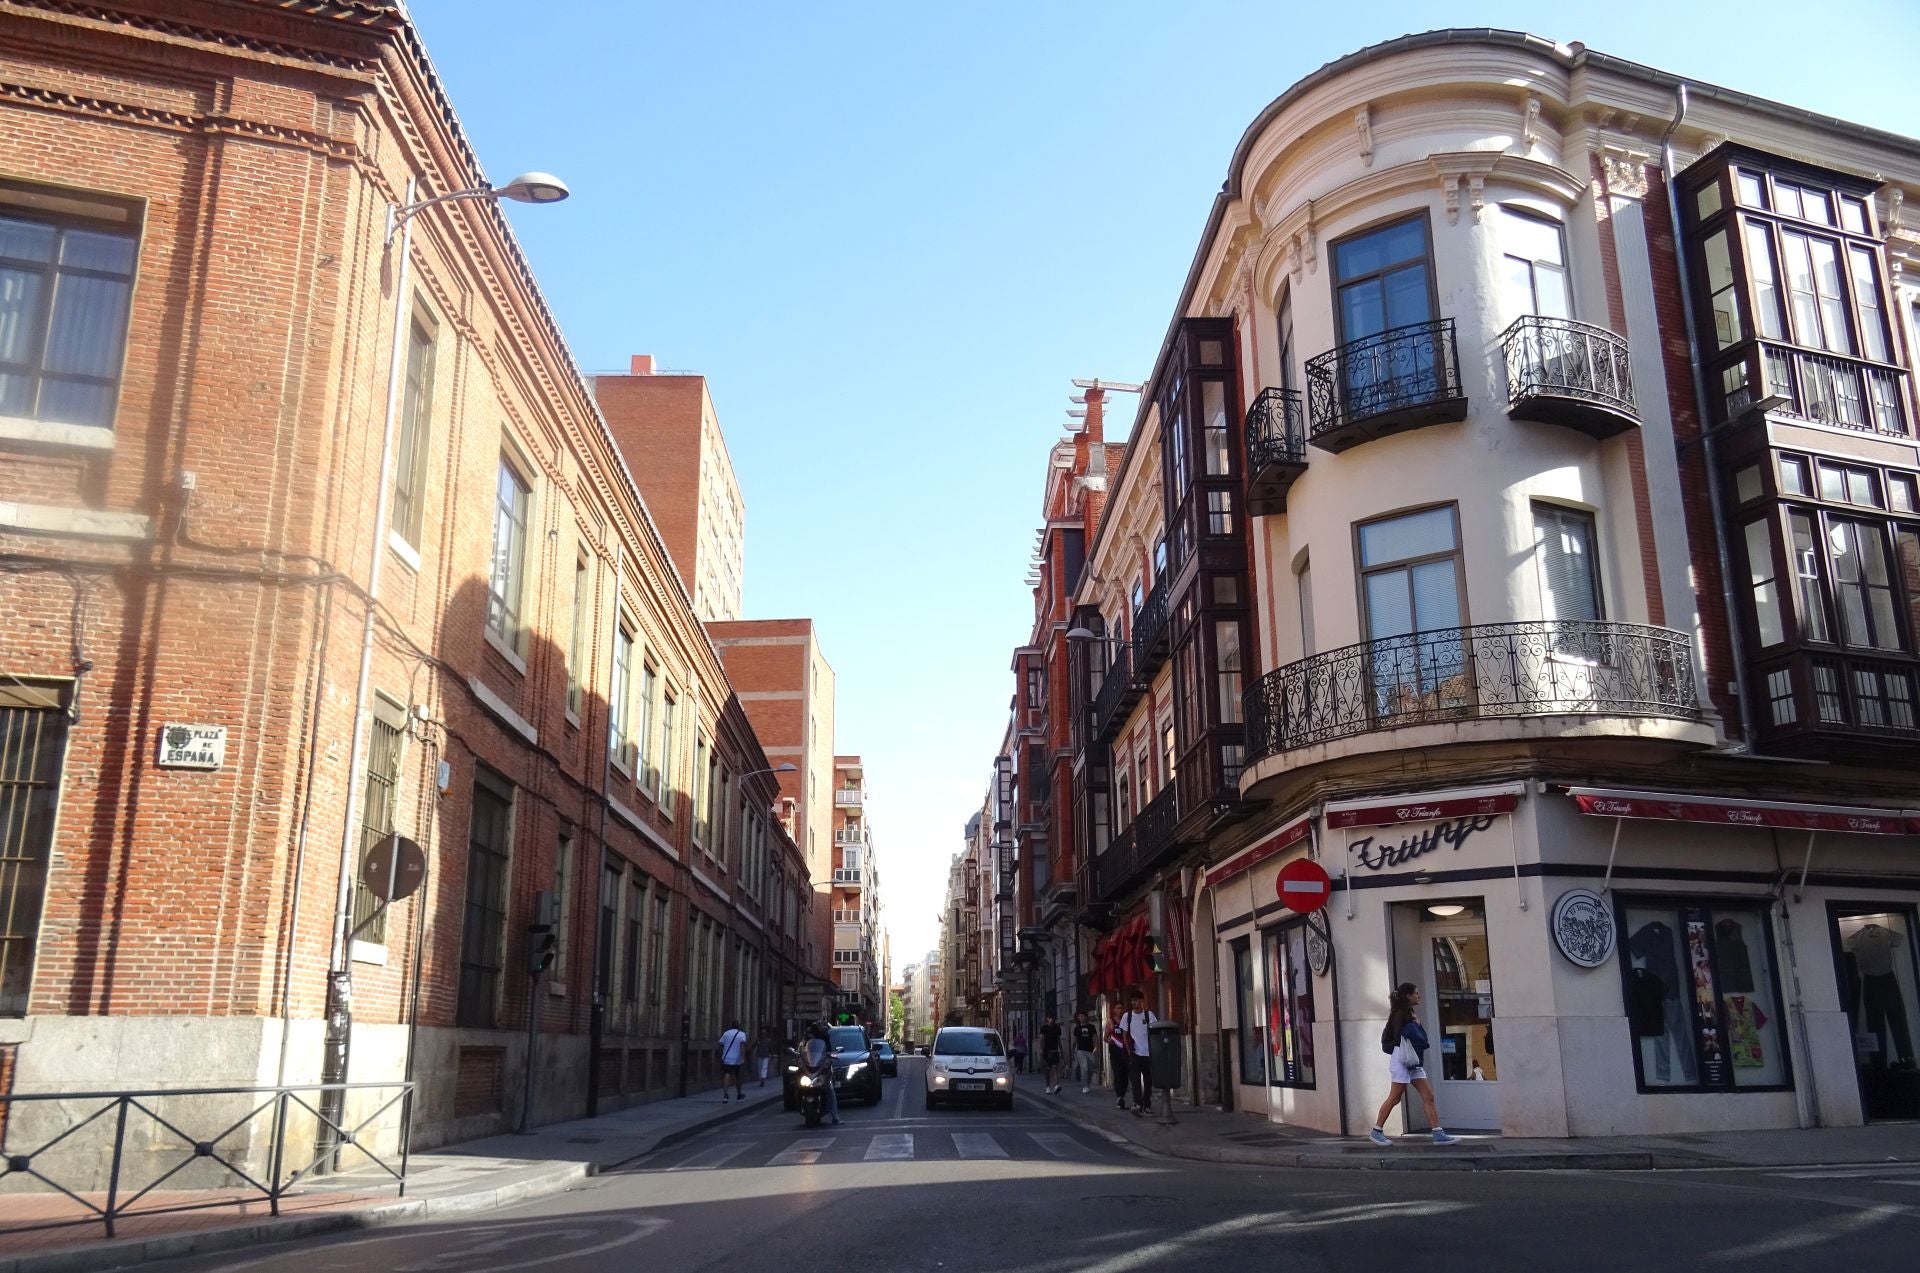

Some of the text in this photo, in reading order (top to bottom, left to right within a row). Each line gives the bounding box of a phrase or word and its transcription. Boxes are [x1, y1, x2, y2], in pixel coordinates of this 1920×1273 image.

[194, 730, 219, 739] PLAZA
[167, 749, 214, 762] ESPAÑA
[1396, 807, 1441, 819] El Triunfo
[1594, 801, 1632, 815] El Triunfo
[1728, 810, 1762, 824] El Triunfo
[1847, 818, 1858, 829] El
[1569, 908, 1576, 916] El
